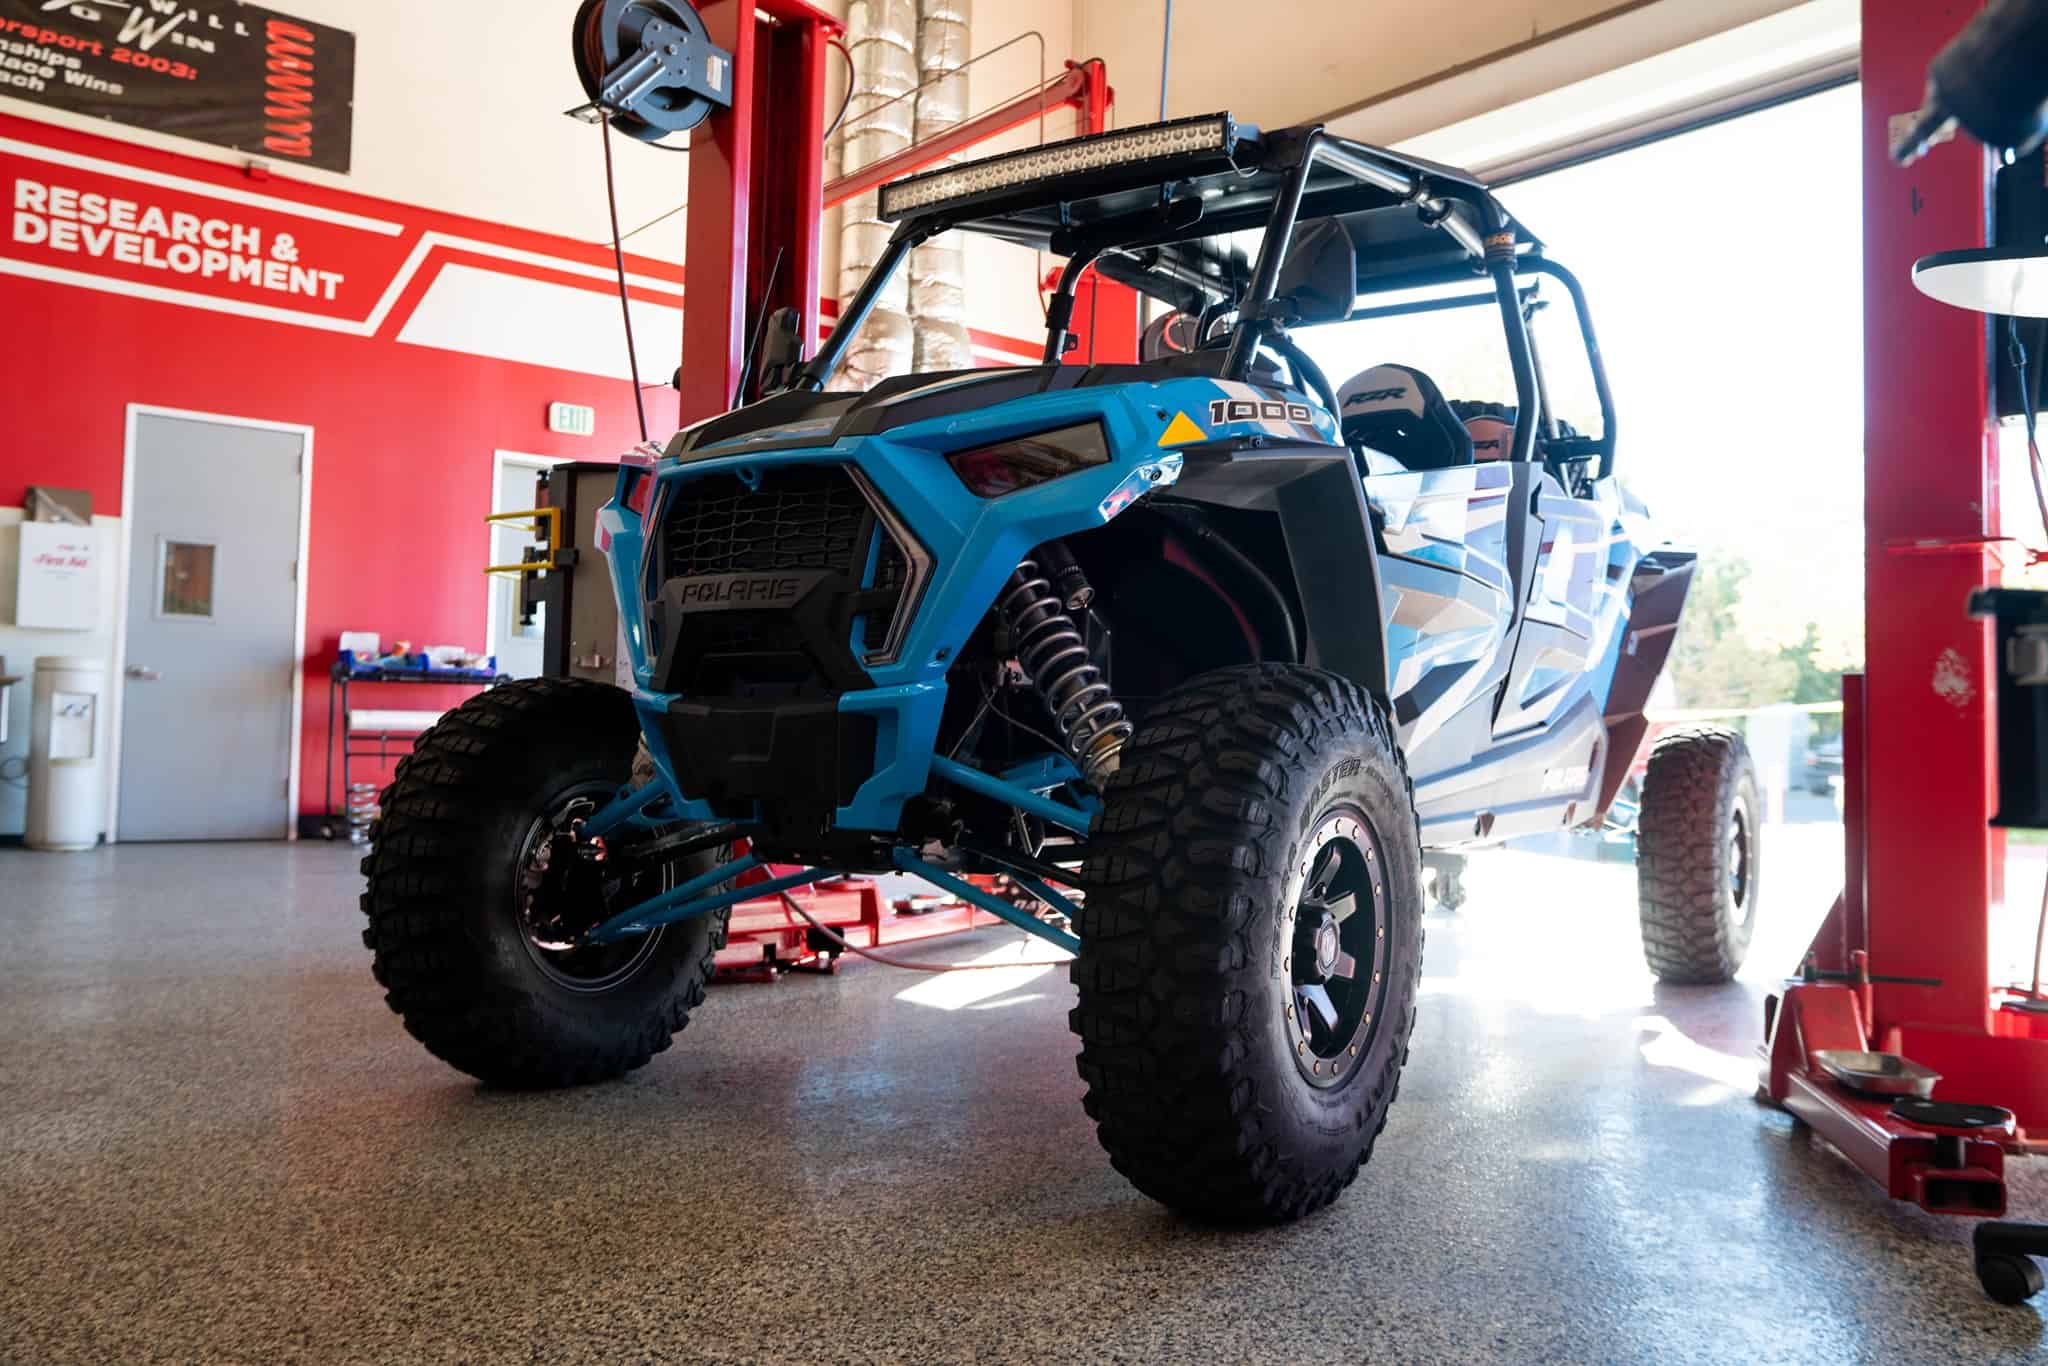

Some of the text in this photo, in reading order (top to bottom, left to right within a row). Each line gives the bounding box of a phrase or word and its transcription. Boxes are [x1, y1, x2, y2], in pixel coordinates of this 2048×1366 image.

[110, 47, 198, 81] 2003:
[64, 69, 124, 95] Wins
[15, 178, 299, 262] RESEARCH &
[12, 210, 345, 300] DEVELOPMENT
[1208, 399, 1313, 426] 1000
[682, 578, 801, 605] POLARIS
